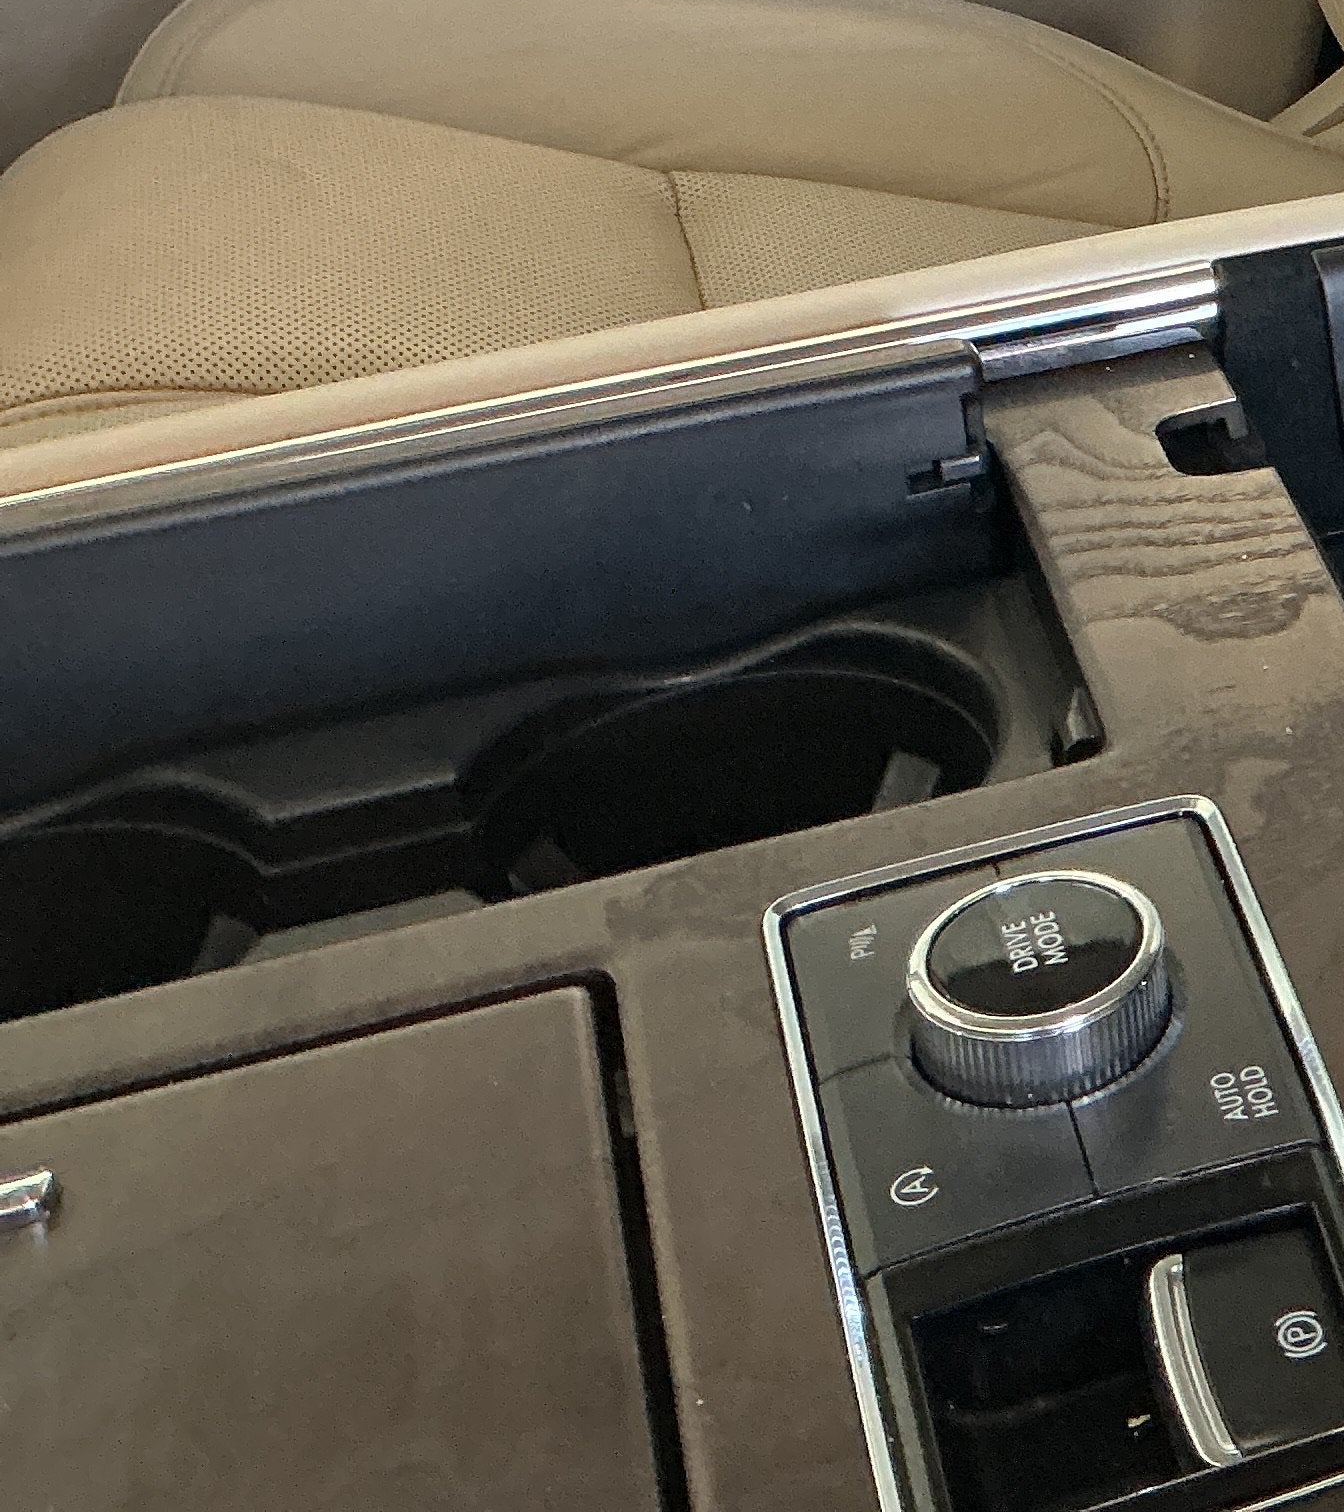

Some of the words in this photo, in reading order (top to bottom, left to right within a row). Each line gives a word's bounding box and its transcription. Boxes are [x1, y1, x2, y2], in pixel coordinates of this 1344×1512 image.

[1002, 919, 1039, 975] DRIVE
[1030, 910, 1069, 966] MODE
[1210, 1072, 1249, 1120] AUTO
[1240, 1065, 1279, 1118] HOLD
